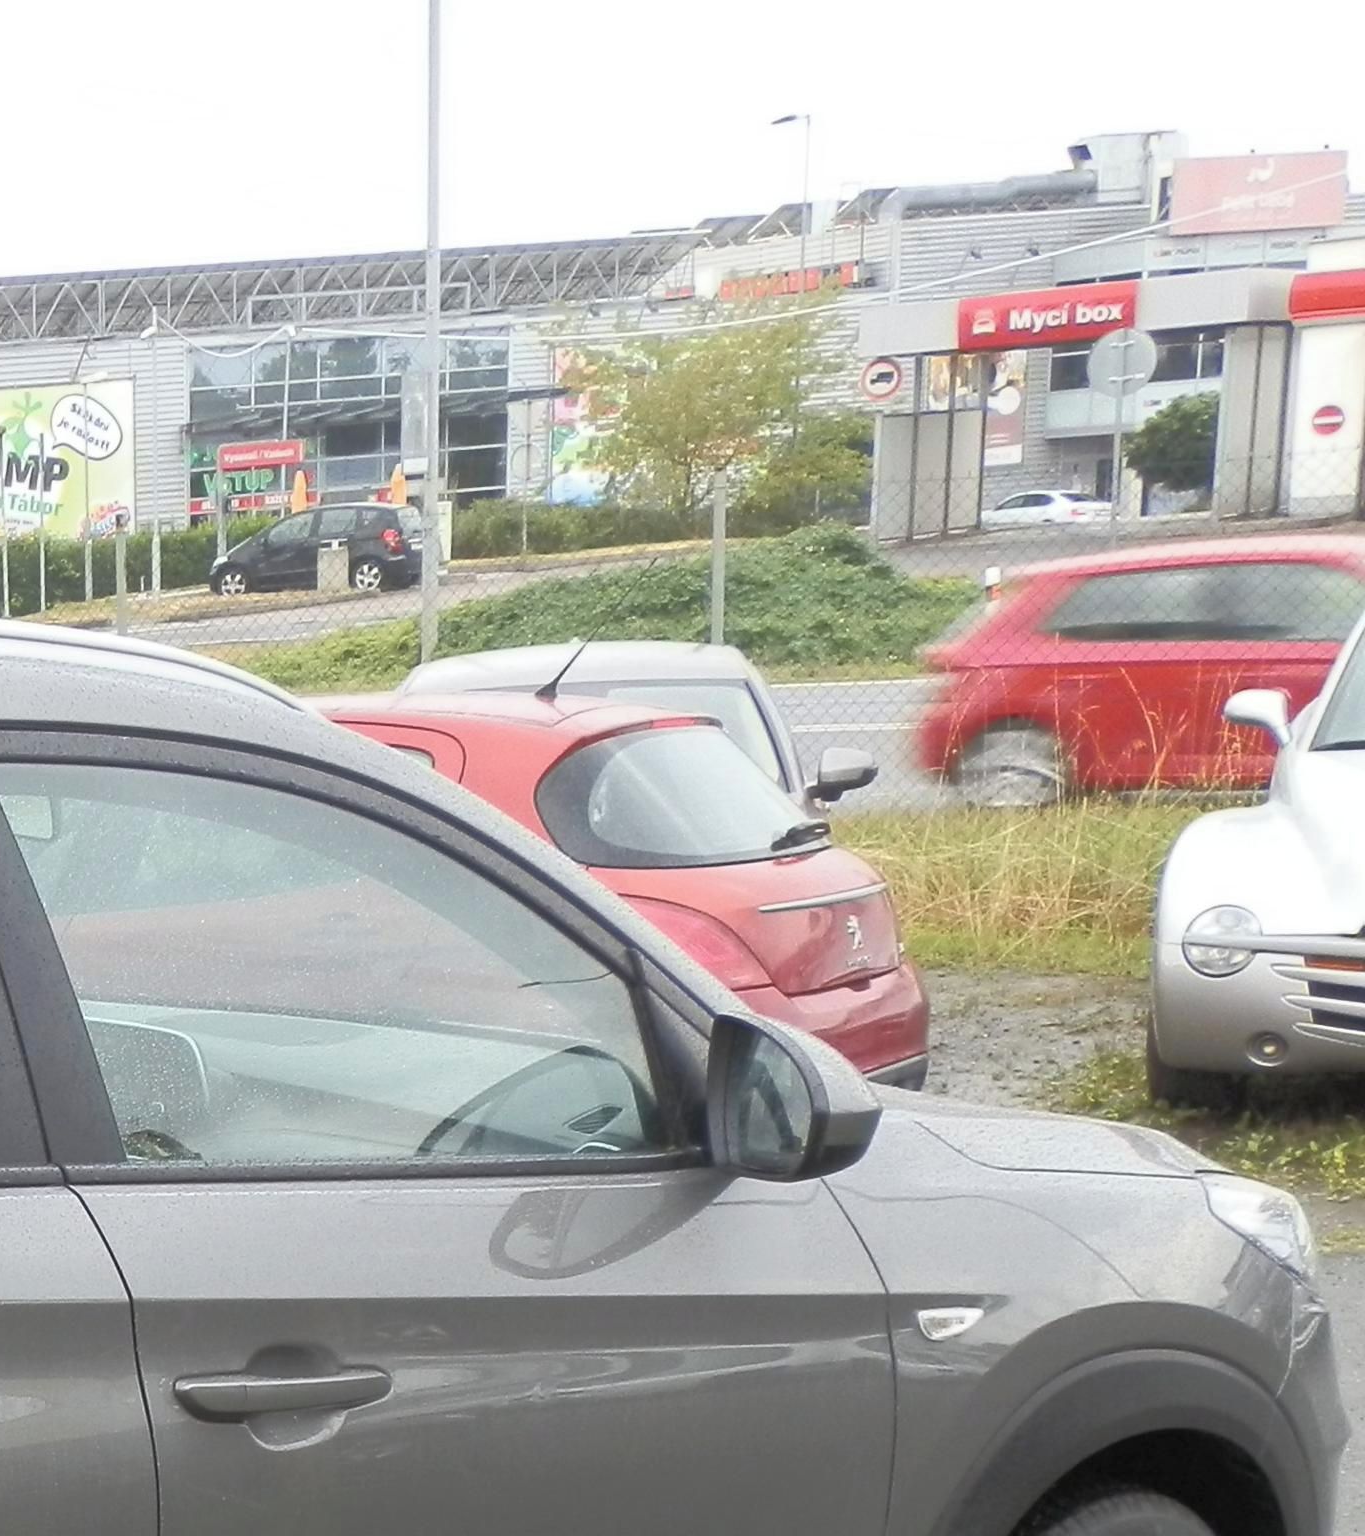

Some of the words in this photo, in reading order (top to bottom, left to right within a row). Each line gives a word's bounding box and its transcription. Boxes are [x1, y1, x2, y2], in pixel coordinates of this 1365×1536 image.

[1009, 303, 1070, 333] Mycí
[1076, 303, 1124, 326] box
[7, 493, 64, 517] Tábor
